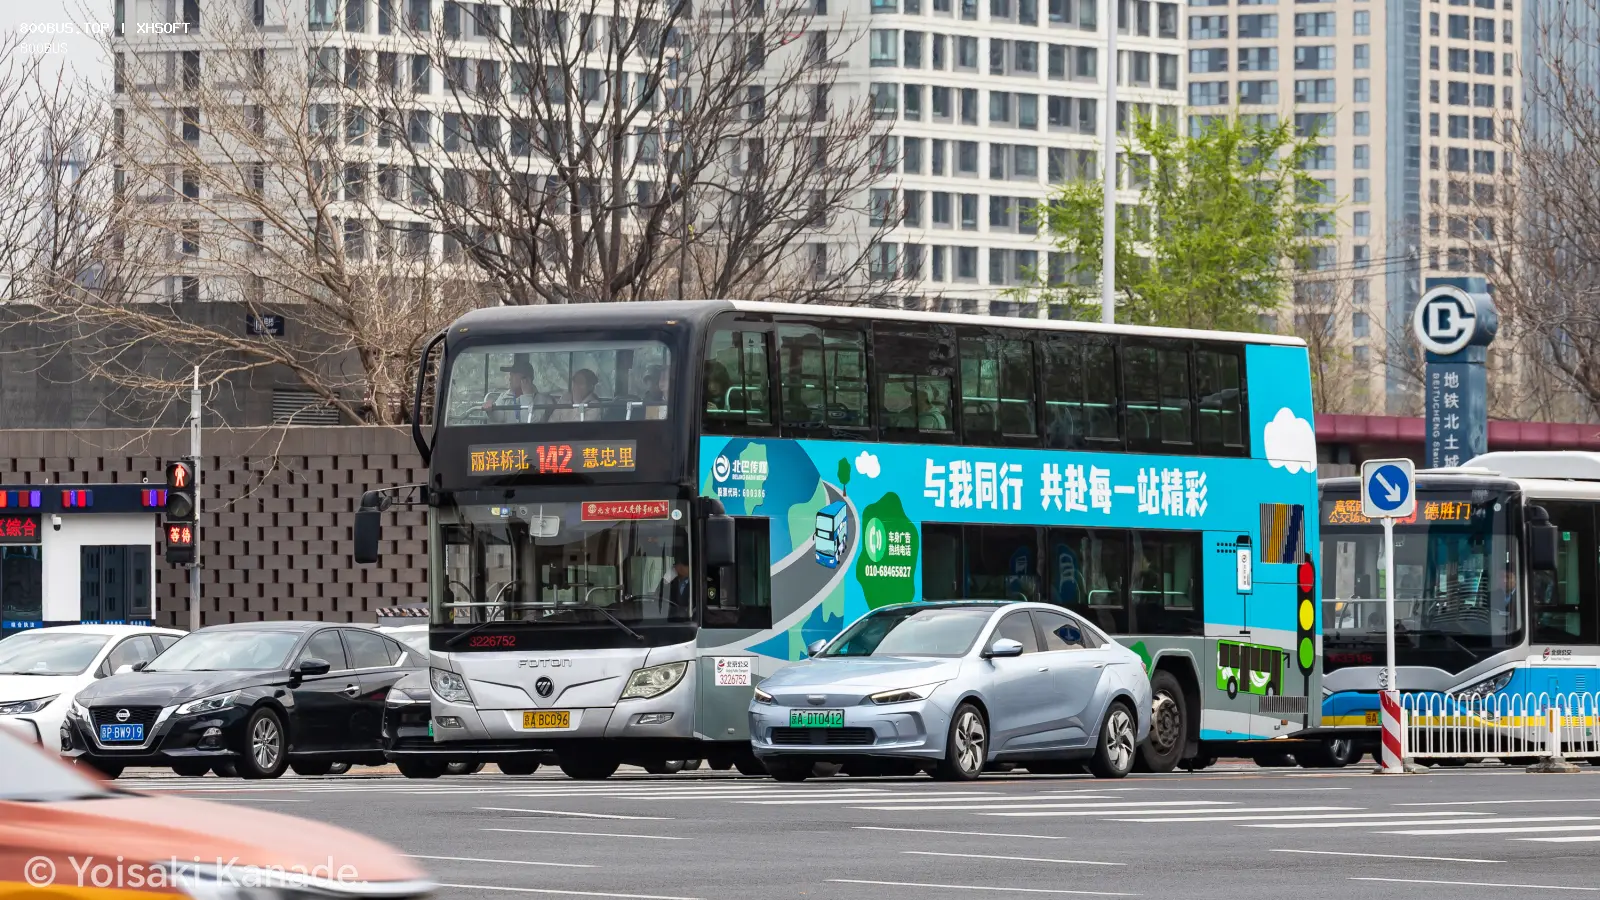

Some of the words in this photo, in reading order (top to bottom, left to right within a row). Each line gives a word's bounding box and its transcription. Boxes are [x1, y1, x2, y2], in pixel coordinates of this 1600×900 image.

[1432, 372, 1440, 438] BEITUCHENG
[1443, 371, 1460, 468] 地铁北土城
[470, 449, 529, 472] 丽泽桥北
[536, 444, 573, 474] 142
[582, 446, 635, 469] 慧忠里
[732, 459, 768, 474] 北巴传媒
[923, 458, 1023, 511] 与我同行
[1040, 462, 1208, 517] 共赴每一站精彩
[1424, 502, 1471, 521] 德胜门
[170, 526, 191, 543] 等待
[888, 531, 911, 544] 车身广告
[888, 544, 911, 556] 热线电话
[865, 564, 911, 578] 010-68465827
[469, 635, 516, 647] 3226752
[518, 658, 573, 668] FOTON
[719, 674, 747, 685] 3226752
